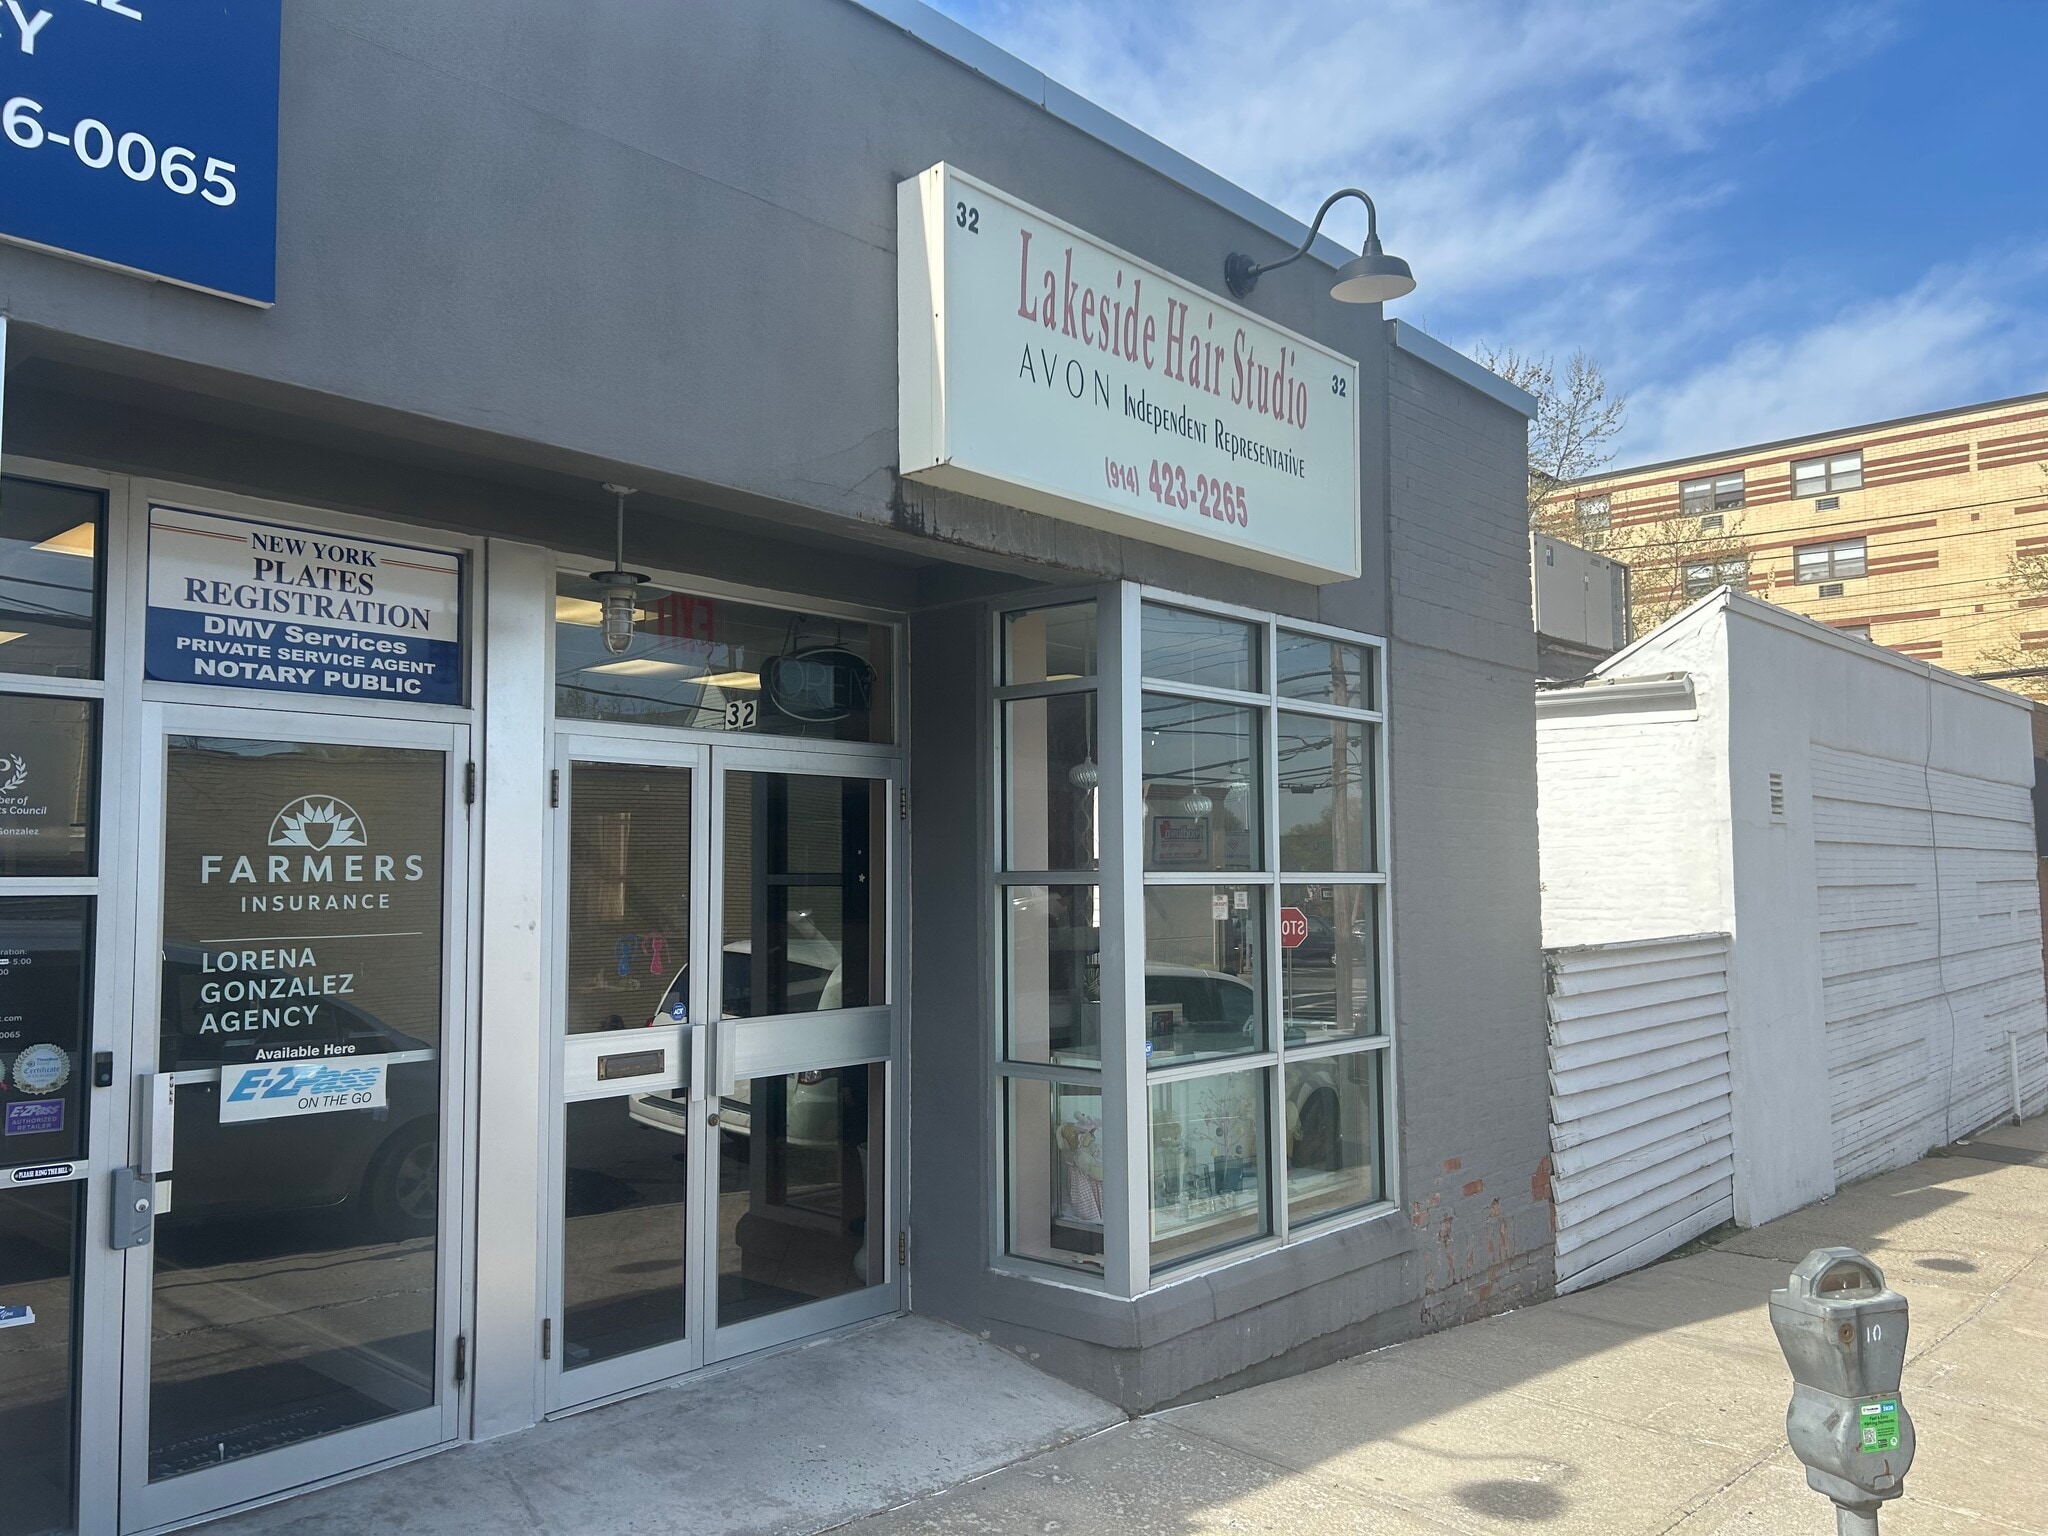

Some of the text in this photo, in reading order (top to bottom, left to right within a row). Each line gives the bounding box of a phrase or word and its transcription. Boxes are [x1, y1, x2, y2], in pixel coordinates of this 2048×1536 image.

[2, 97, 236, 206] 6-0065
[956, 201, 979, 234] 32
[1018, 228, 1308, 430] Lakeside Hair Studio
[1019, 342, 1110, 411] AVON
[1332, 374, 1346, 397] 32
[1105, 456, 1248, 528] (914) 423-2265
[251, 532, 377, 567] NEW YORK
[253, 557, 374, 596] PLATES
[184, 577, 431, 631] REGISTRATION
[204, 615, 408, 655] DMV Services
[176, 636, 436, 675] PRIVATE SERVICE AGENT
[194, 657, 422, 695] NOTARY PUBLIC
[727, 702, 755, 728] 32
[9, 806, 47, 815] Council
[17, 796, 28, 806] of
[202, 855, 424, 884] FARMERS
[241, 893, 390, 912] INSURANCE
[202, 947, 317, 973] LORENA
[200, 973, 355, 1004] GONZALEZ
[199, 1004, 320, 1035] AGENCY
[255, 1044, 356, 1060] Available Here
[298, 1092, 372, 1109] ON THE GO
[12, 1117, 57, 1125] AUTHORIZED
[17, 1123, 51, 1131] RETAILER
